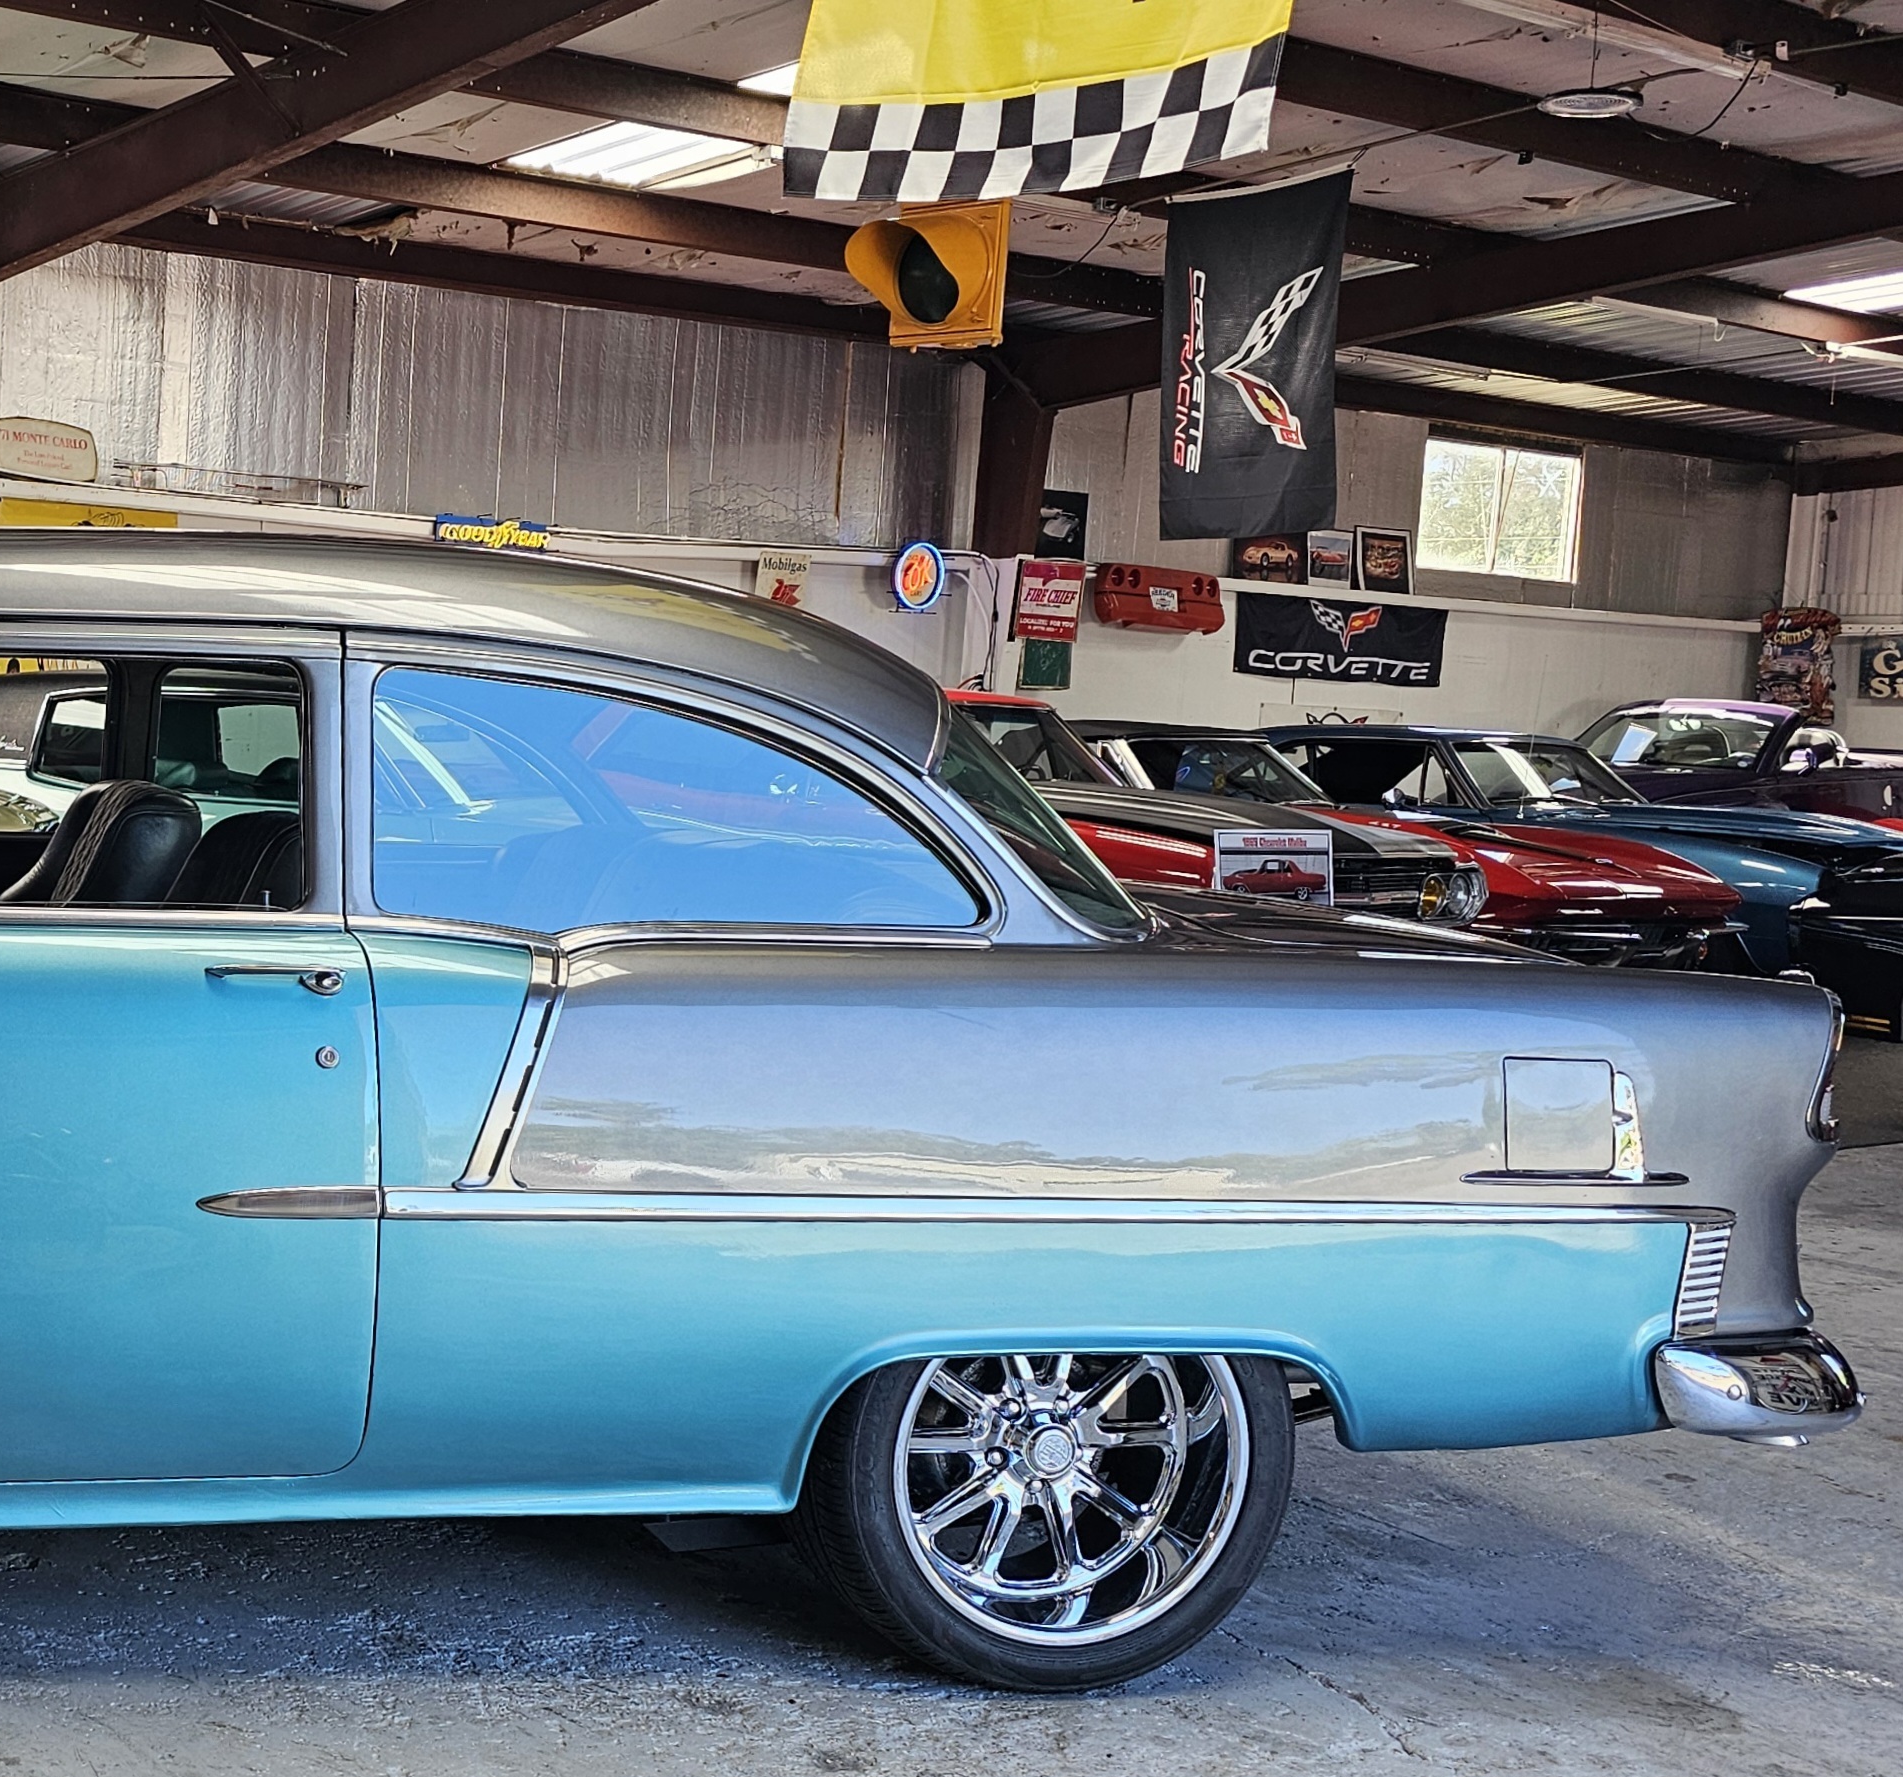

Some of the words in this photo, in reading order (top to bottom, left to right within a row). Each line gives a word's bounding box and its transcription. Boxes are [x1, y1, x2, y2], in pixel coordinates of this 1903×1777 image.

[1173, 267, 1194, 467] RACING
[1184, 269, 1206, 474] CORVETTE
[12, 431, 50, 446] MONTE
[52, 436, 88, 450] CARLO
[438, 521, 552, 549] GOODYEAR
[761, 557, 808, 575] Mobilgas
[1023, 588, 1050, 603] FIRE
[1047, 589, 1079, 605] CHIEF
[1248, 649, 1431, 681] CORVETTE
